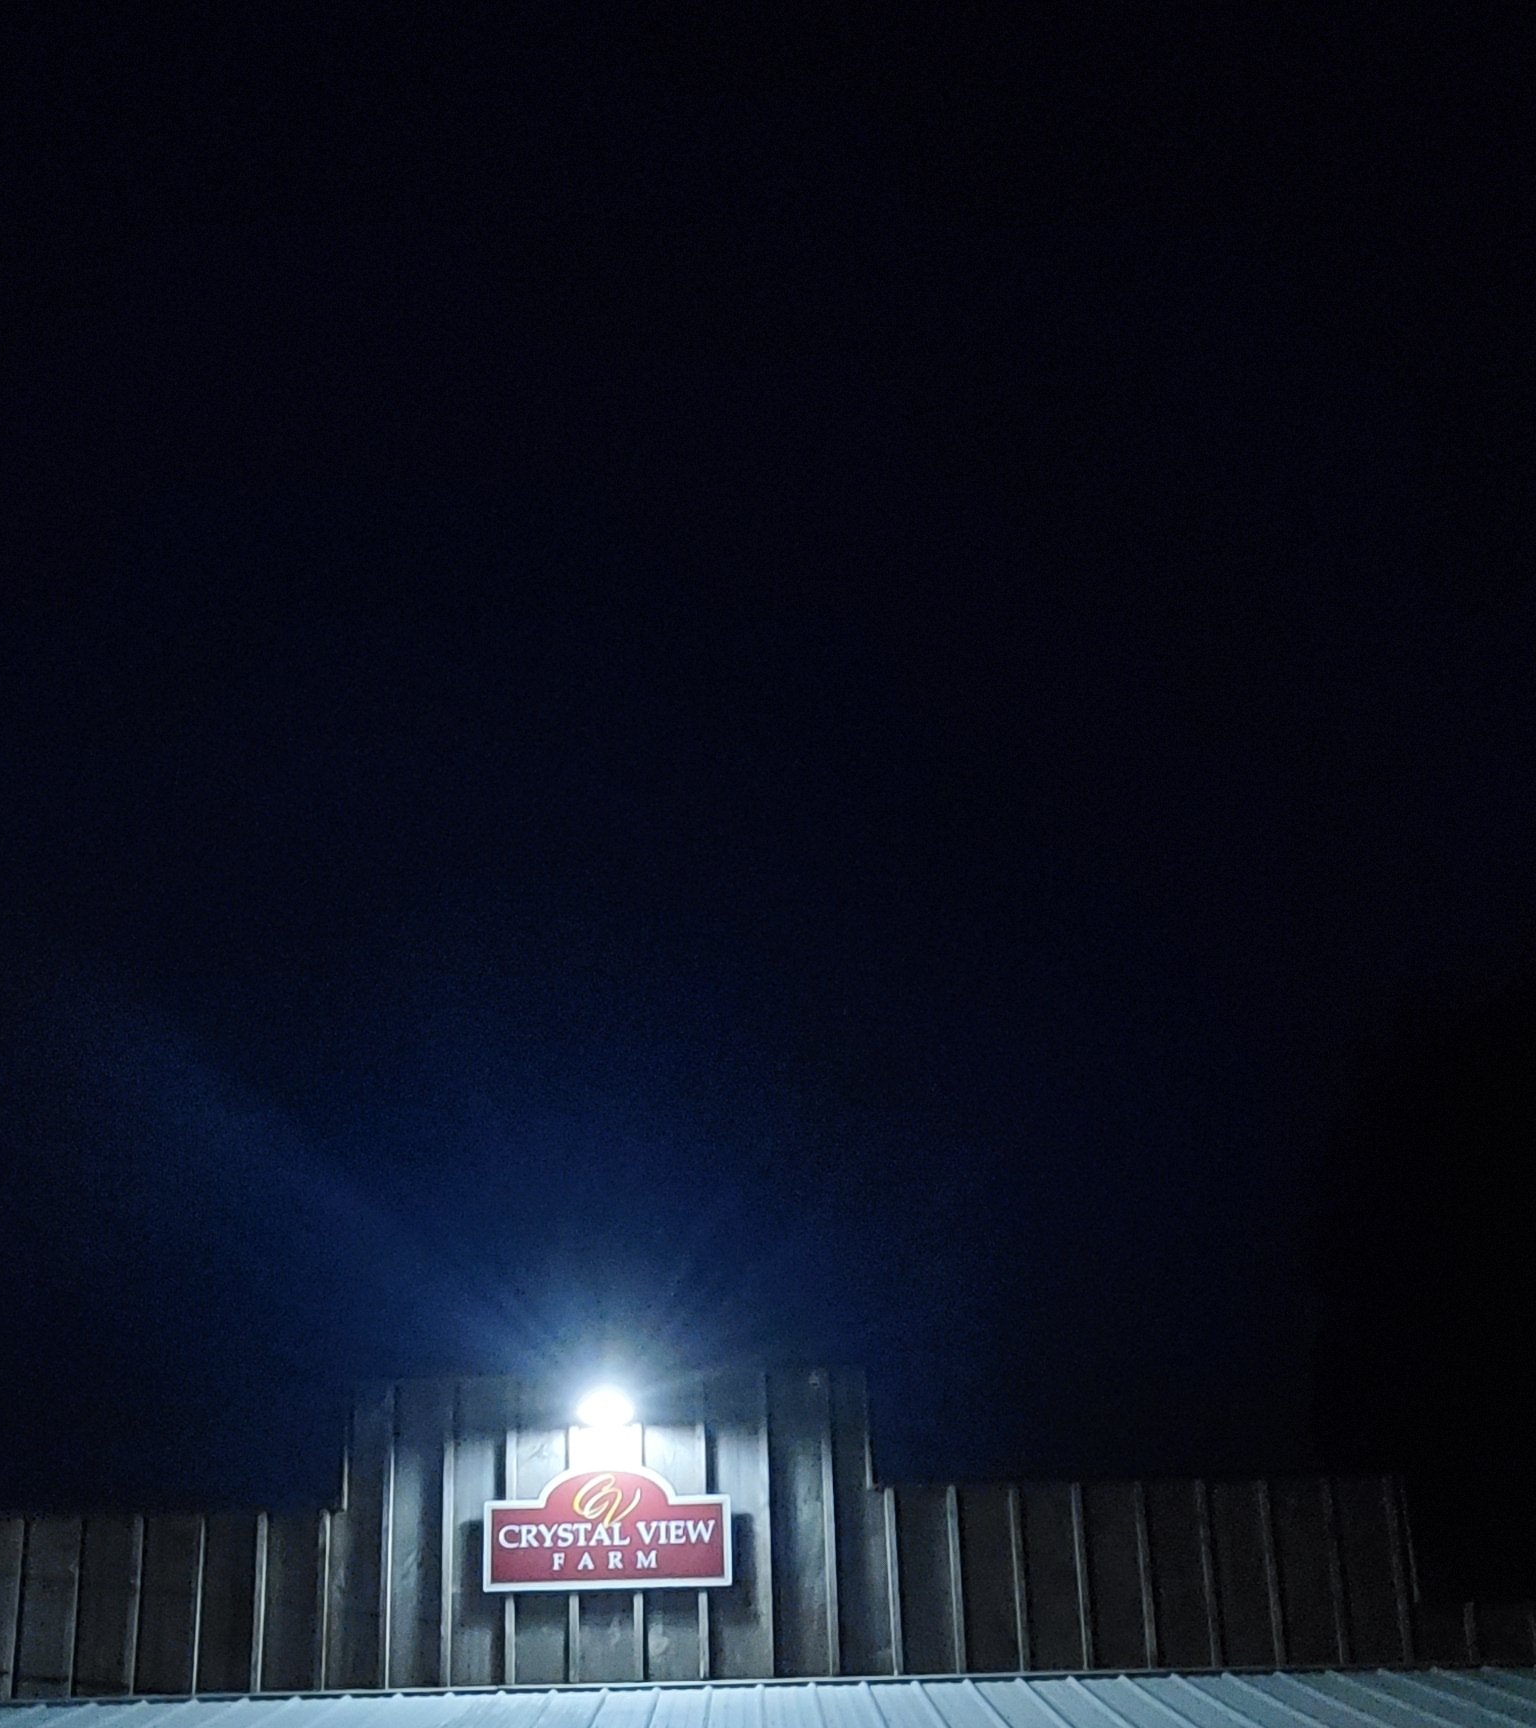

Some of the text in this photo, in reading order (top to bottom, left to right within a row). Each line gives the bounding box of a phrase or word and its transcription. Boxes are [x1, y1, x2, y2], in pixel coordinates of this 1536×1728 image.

[498, 1520, 715, 1549] CRYSTAL VIEW
[552, 1550, 658, 1571] FARM
